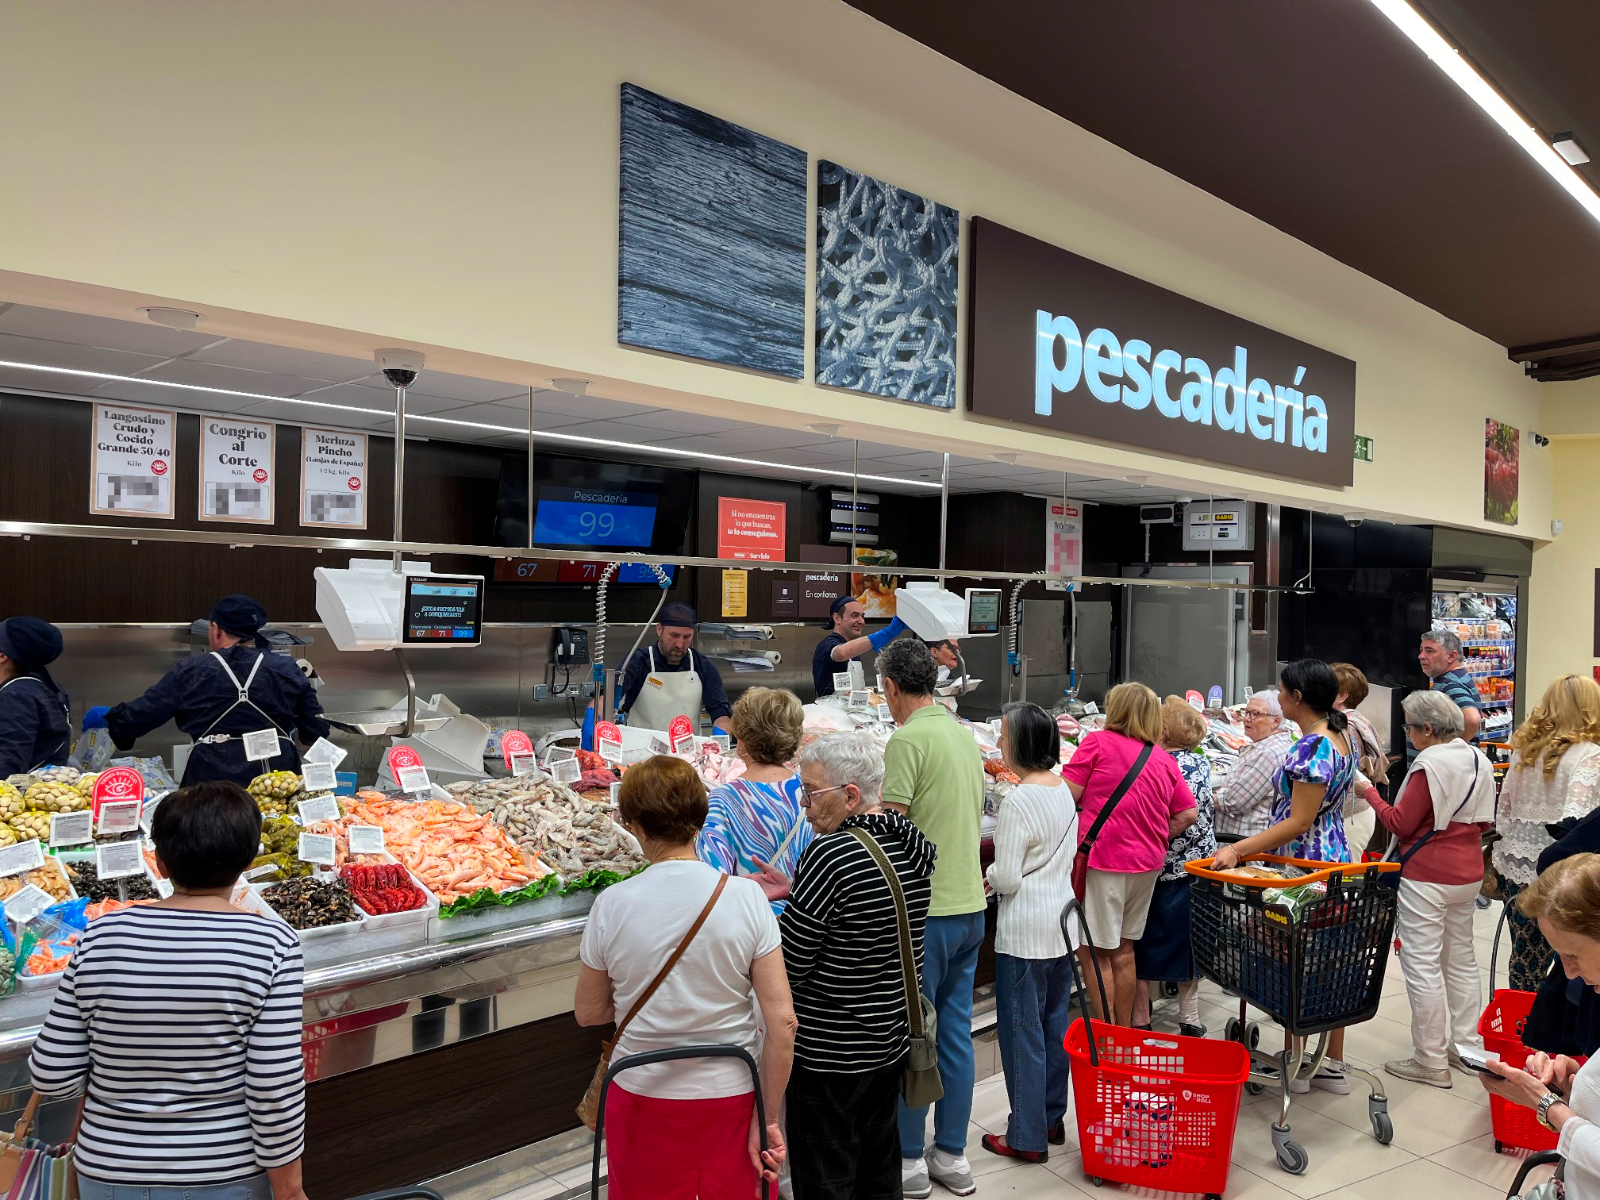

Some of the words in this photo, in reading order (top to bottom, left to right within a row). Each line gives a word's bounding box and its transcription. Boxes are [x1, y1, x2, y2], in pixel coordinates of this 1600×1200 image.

[1035, 309, 1328, 453] pescadería
[104, 410, 166, 426] Langostino
[113, 422, 148, 434] Crudo
[150, 428, 156, 437] y
[209, 423, 267, 440] Congrio
[116, 433, 154, 445] Cocido
[315, 434, 356, 447] Merluza
[97, 442, 139, 454] Grande
[231, 440, 245, 452] al
[318, 445, 352, 457] Pincho
[218, 453, 258, 467] Corte
[306, 456, 330, 464] (Lonjas
[339, 459, 364, 467] España)
[574, 490, 628, 504] Pescadería
[746, 512, 776, 521] encuentras
[578, 511, 615, 538] 99
[742, 520, 752, 528] que
[752, 521, 772, 529] buscas,
[741, 530, 778, 538] conseguimos.
[517, 563, 538, 577] 67
[582, 564, 596, 578] 71
[638, 566, 654, 579] 99
[805, 573, 839, 582] pescadería
[805, 590, 813, 598] En
[814, 590, 838, 598] confianza
[416, 629, 425, 637] 67
[100, 772, 115, 785] TIENES
[1264, 909, 1288, 925] GADIS
